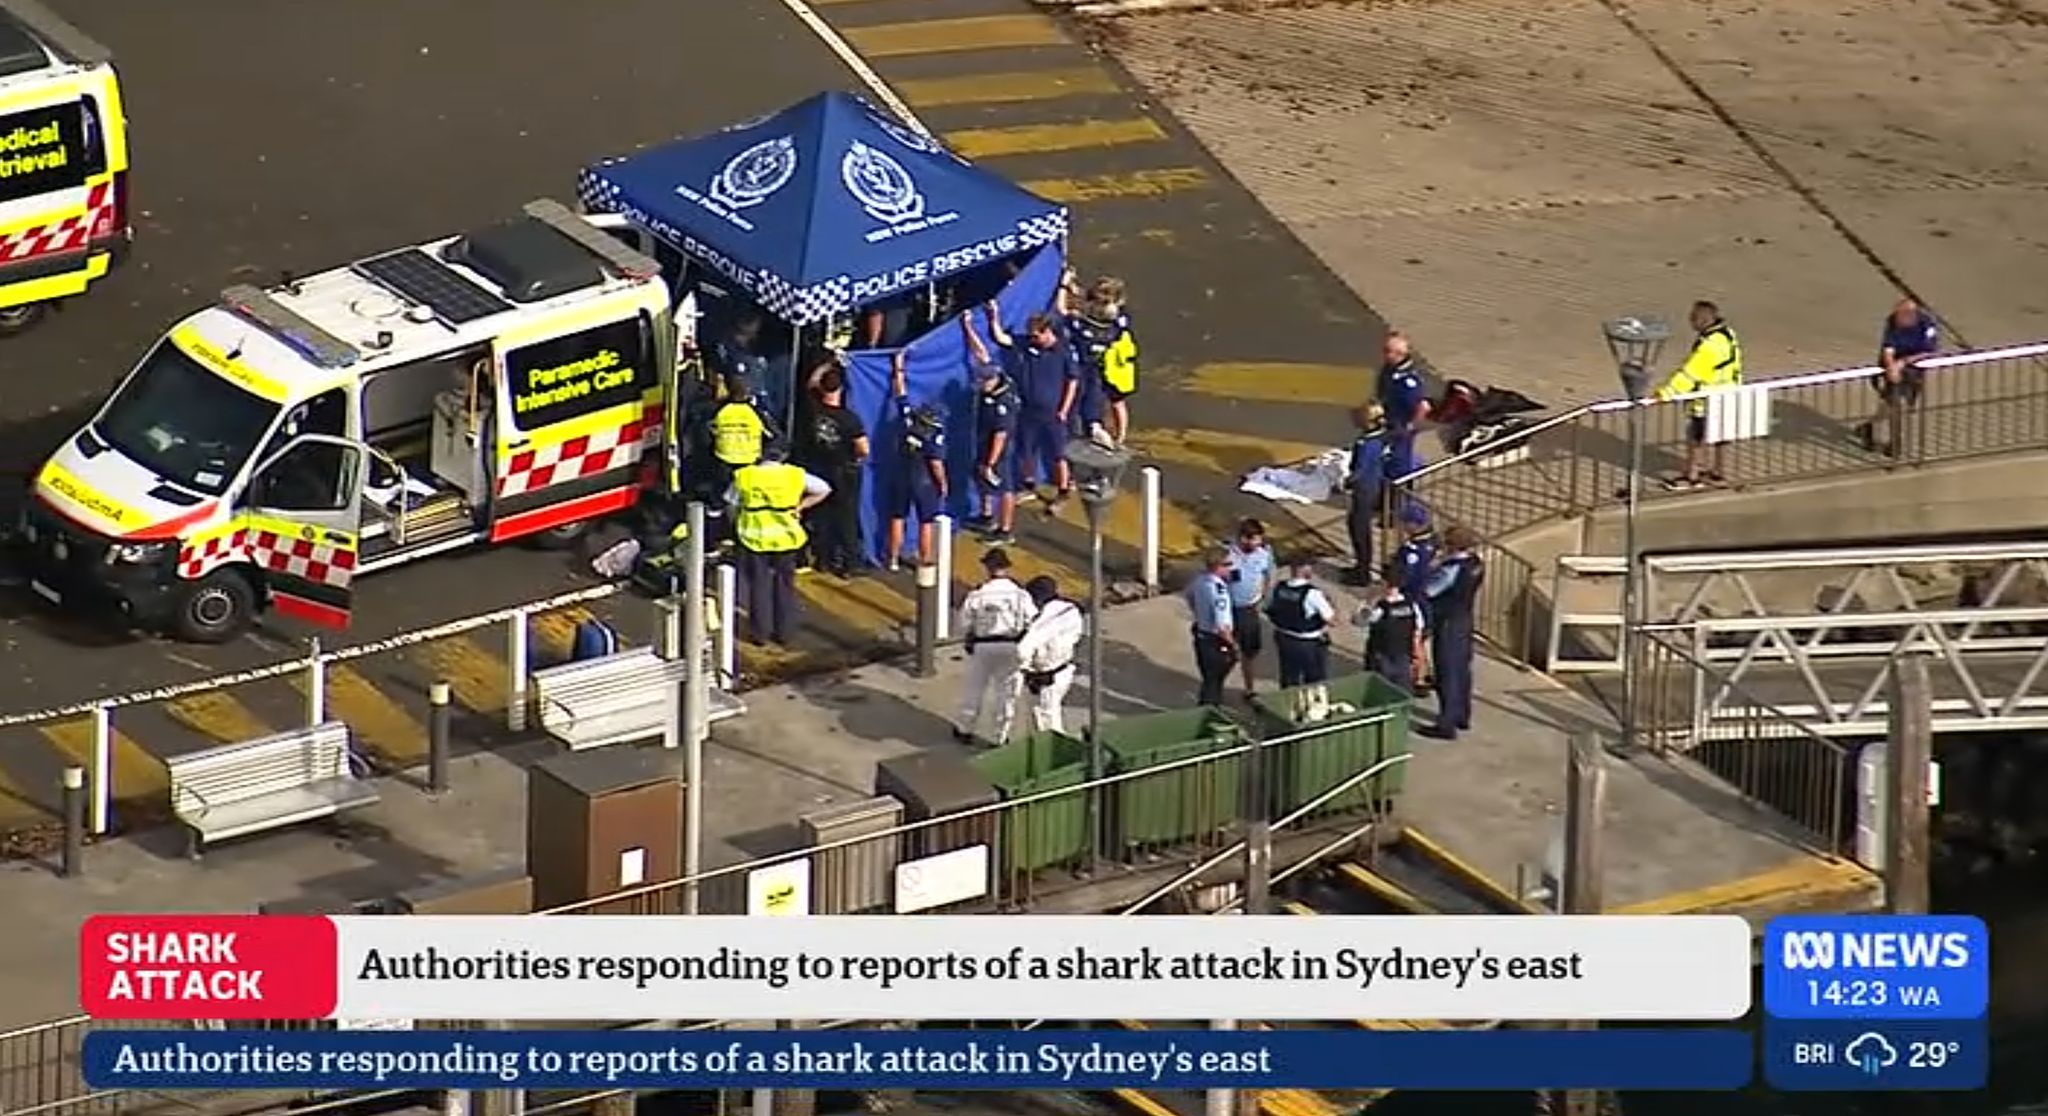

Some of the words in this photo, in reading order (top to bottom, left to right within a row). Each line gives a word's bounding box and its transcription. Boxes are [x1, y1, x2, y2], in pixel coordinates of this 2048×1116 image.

[852, 261, 928, 301] POLICE
[932, 234, 1017, 276] RESCUE
[516, 379, 591, 413] Intensive
[593, 367, 635, 390] Care
[528, 349, 620, 389] Paramedic
